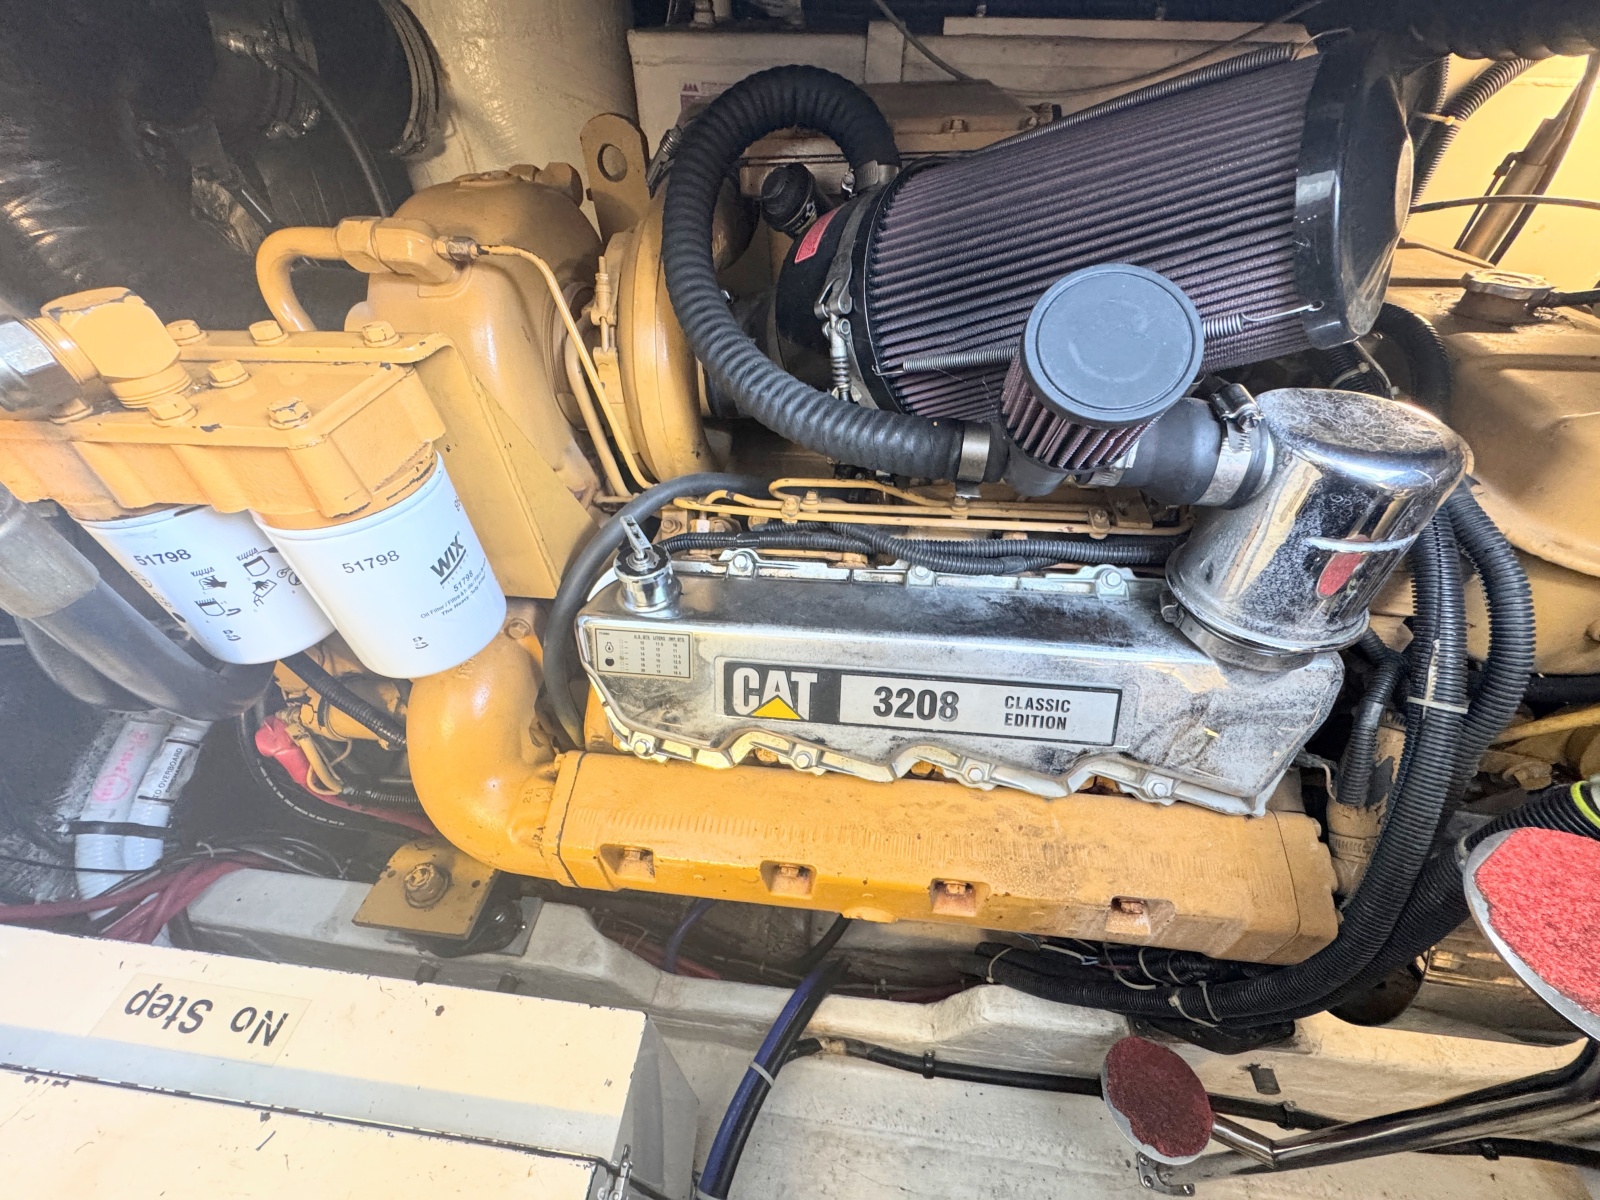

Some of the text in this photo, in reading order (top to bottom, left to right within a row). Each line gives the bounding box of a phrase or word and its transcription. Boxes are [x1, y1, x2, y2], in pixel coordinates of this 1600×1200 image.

[133, 549, 192, 567] 51798
[342, 550, 400, 574] 51798
[430, 534, 465, 577] WIX
[453, 570, 474, 592] 51798
[732, 667, 818, 721] CAT
[873, 686, 960, 722] 3208
[1004, 695, 1071, 713] CLASSIC
[1004, 712, 1068, 731] EDITION
[160, 747, 183, 789] OVERBOARD
[124, 983, 289, 1047] No Step
